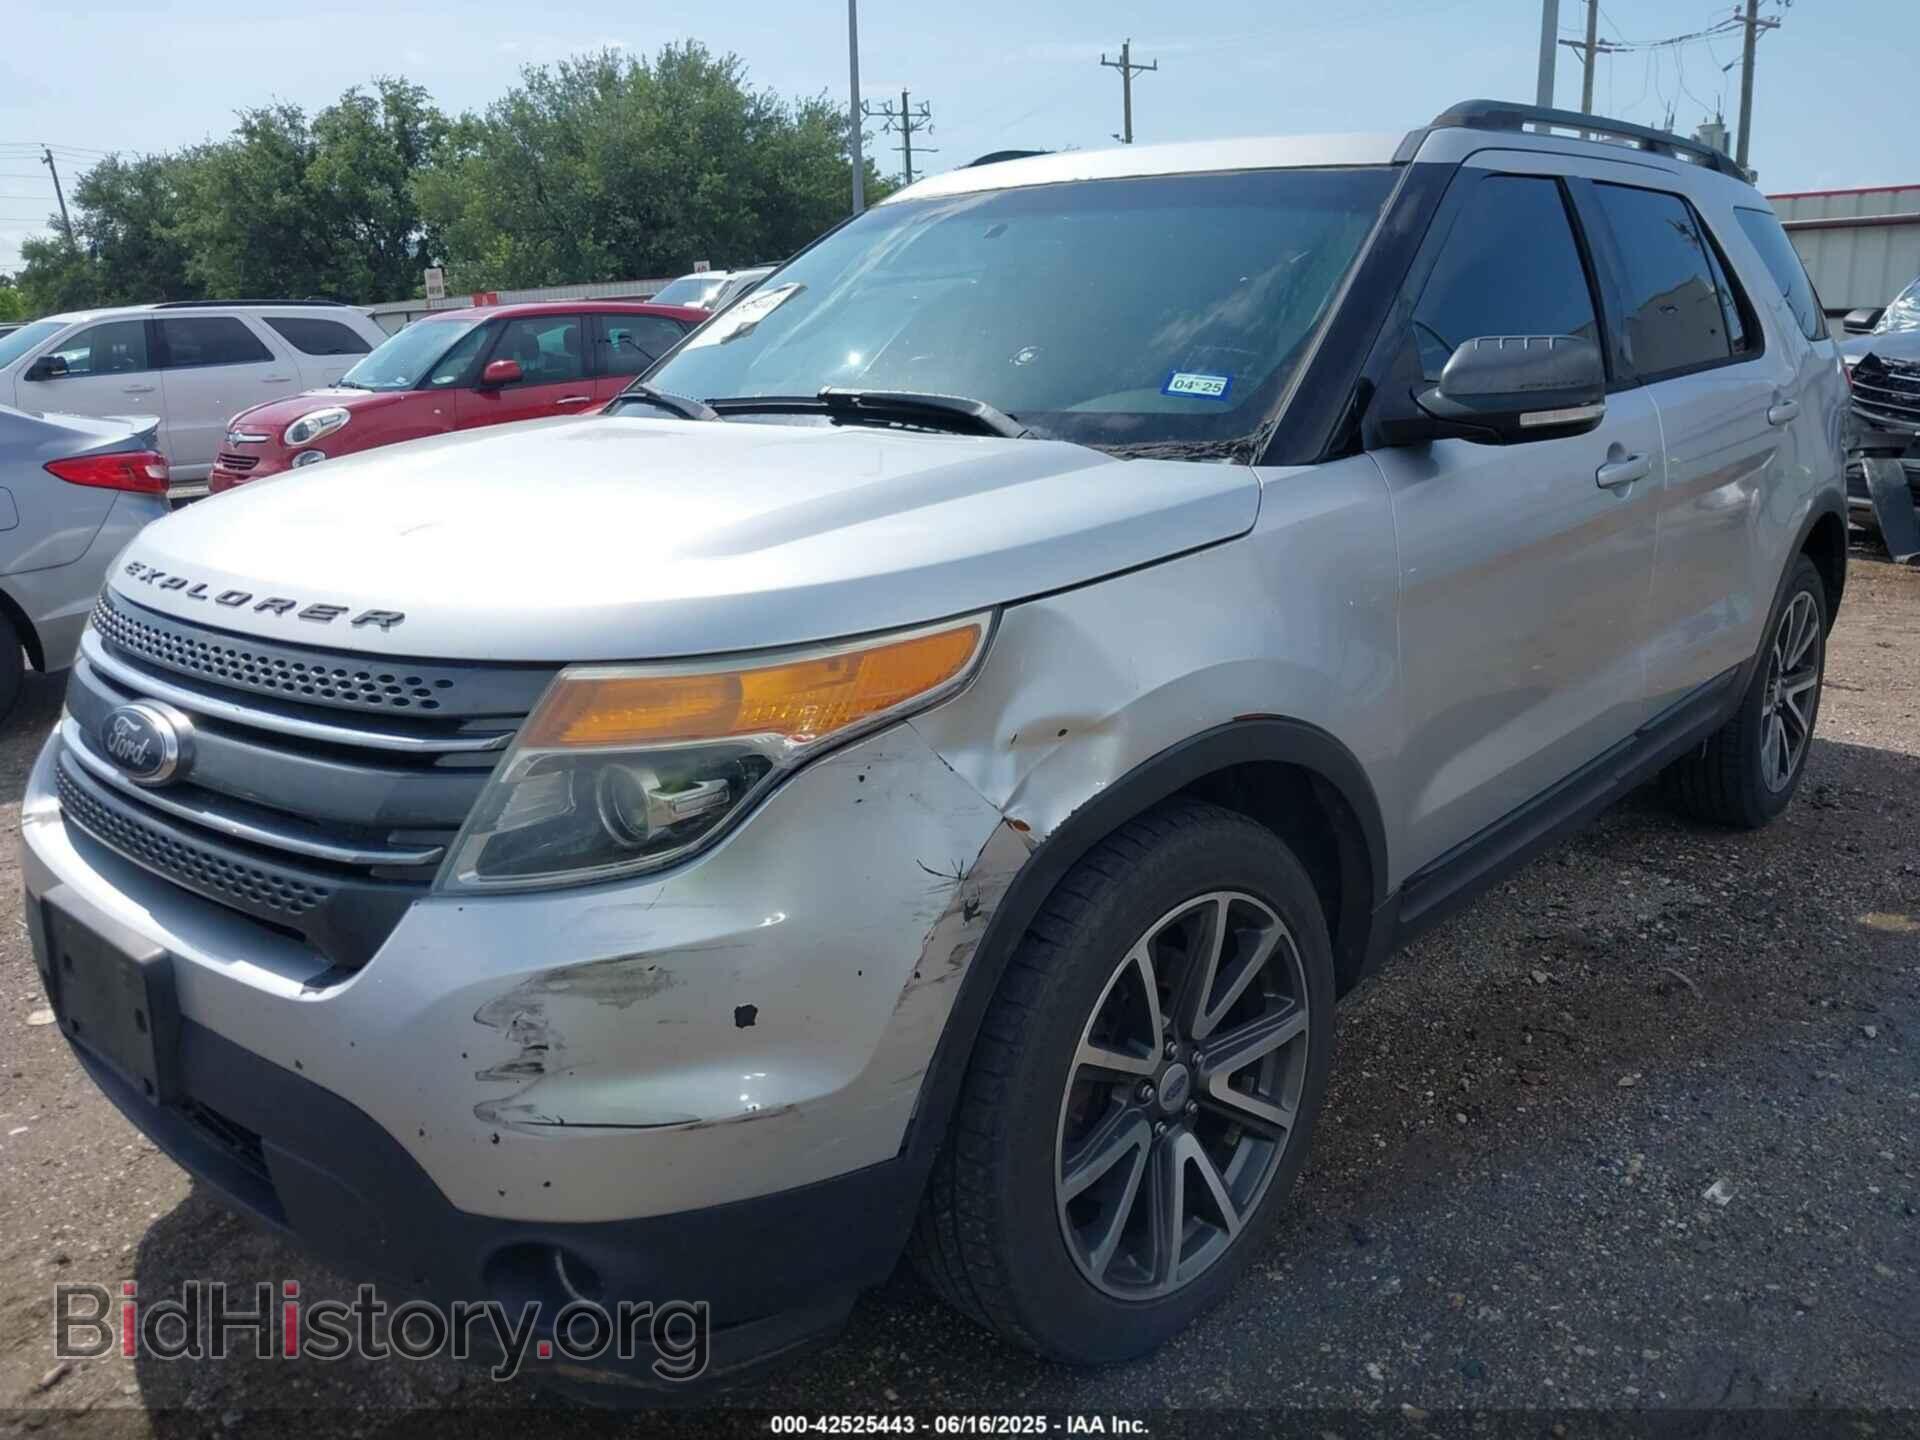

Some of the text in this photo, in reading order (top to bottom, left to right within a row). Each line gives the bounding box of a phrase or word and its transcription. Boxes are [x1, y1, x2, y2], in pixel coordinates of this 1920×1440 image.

[1201, 382, 1223, 393] 25
[124, 560, 405, 632] EXPLORER
[106, 715, 150, 766] Ford
